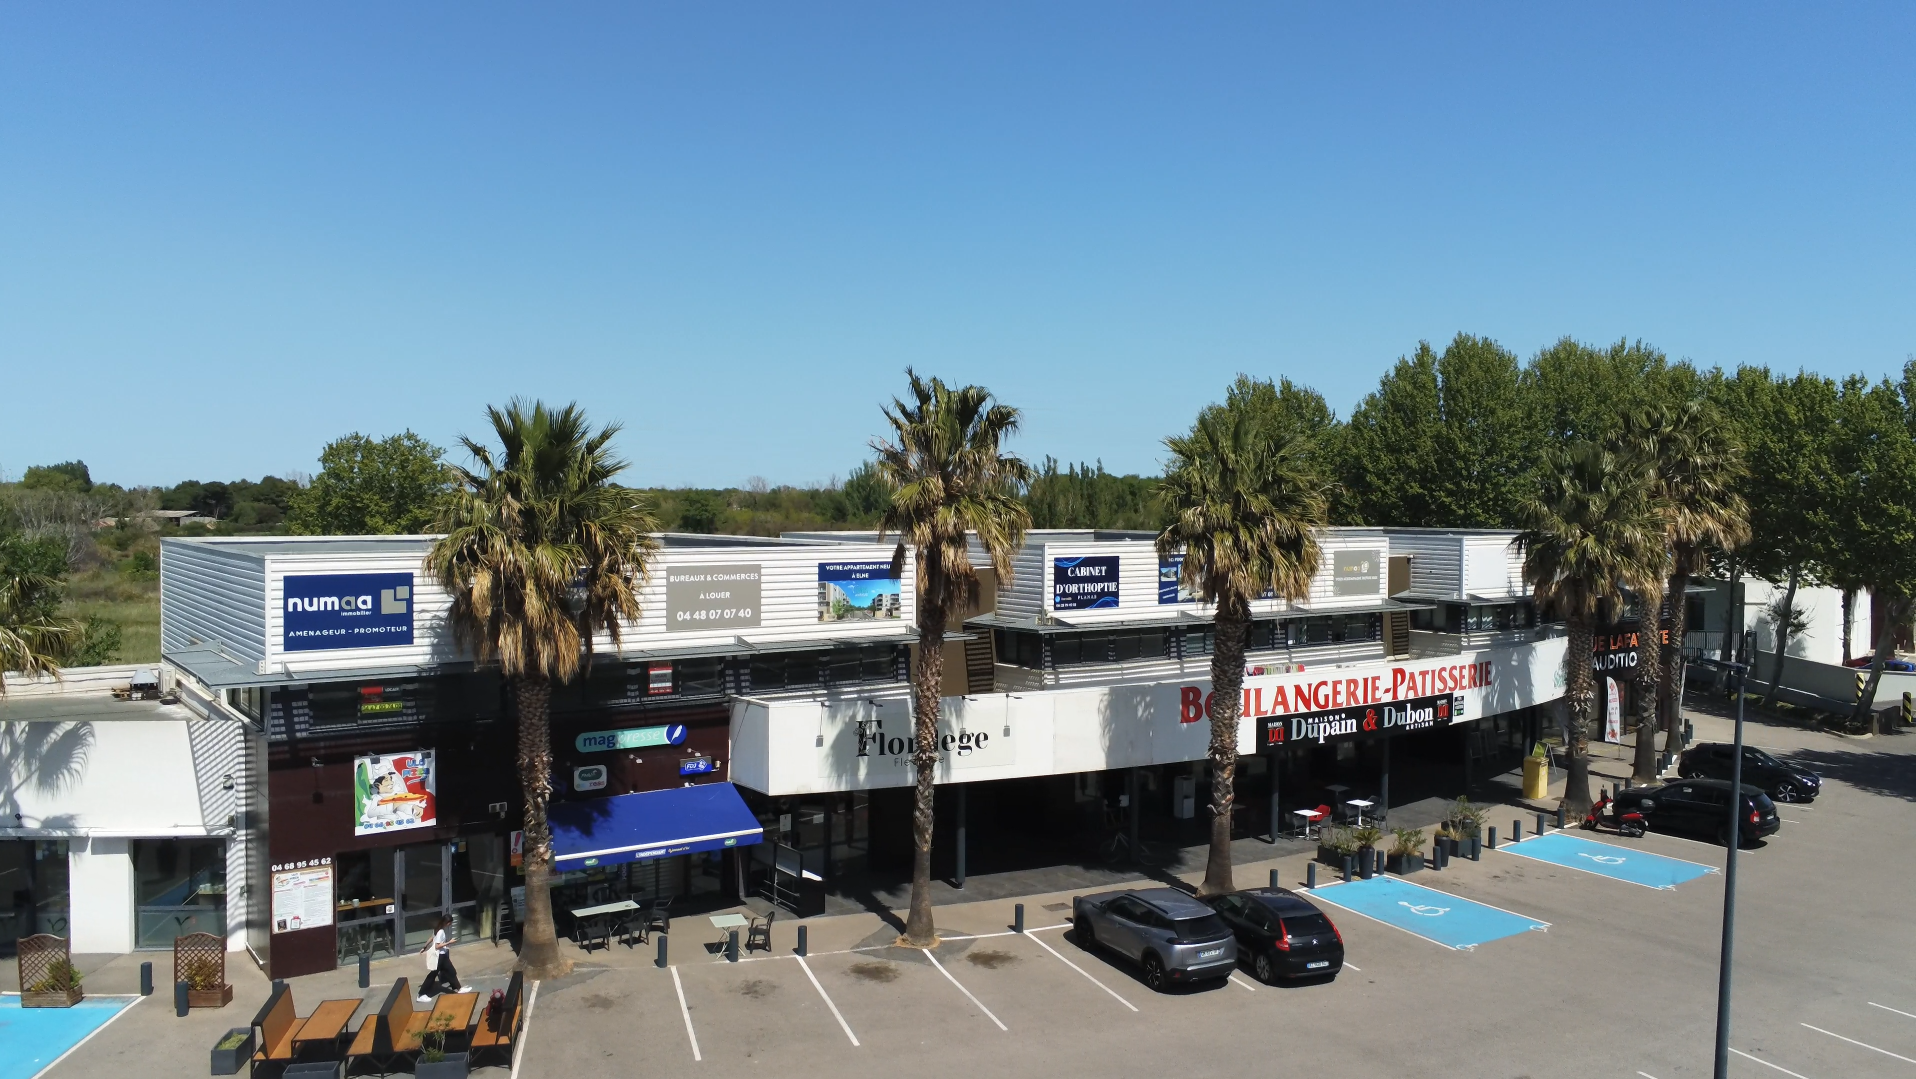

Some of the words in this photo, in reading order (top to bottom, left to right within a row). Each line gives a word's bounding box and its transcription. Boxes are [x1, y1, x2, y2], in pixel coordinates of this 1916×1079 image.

[669, 574, 705, 582] BUREAUX
[712, 573, 759, 581] COMMERCES
[1068, 566, 1107, 577] CABINET
[1056, 582, 1118, 594] D'ORTHOPTIE
[706, 591, 731, 599] LOUER
[287, 595, 372, 612] numaa
[676, 610, 691, 621] 04
[692, 610, 707, 620] 48
[708, 609, 722, 619] 07
[723, 608, 737, 618] 07
[737, 608, 752, 618] 40
[288, 628, 346, 637] AMENAGEUR
[354, 625, 408, 634] PROMOTEUR
[1592, 651, 1638, 671] AUDITIO
[1383, 703, 1434, 728] Dubon
[1290, 713, 1358, 744] Dupain
[1362, 708, 1378, 732] &
[1405, 721, 1434, 731] ARTISAN
[271, 863, 283, 872] 04
[284, 862, 295, 870] 68
[296, 860, 307, 868] 95
[320, 857, 332, 865] 62
